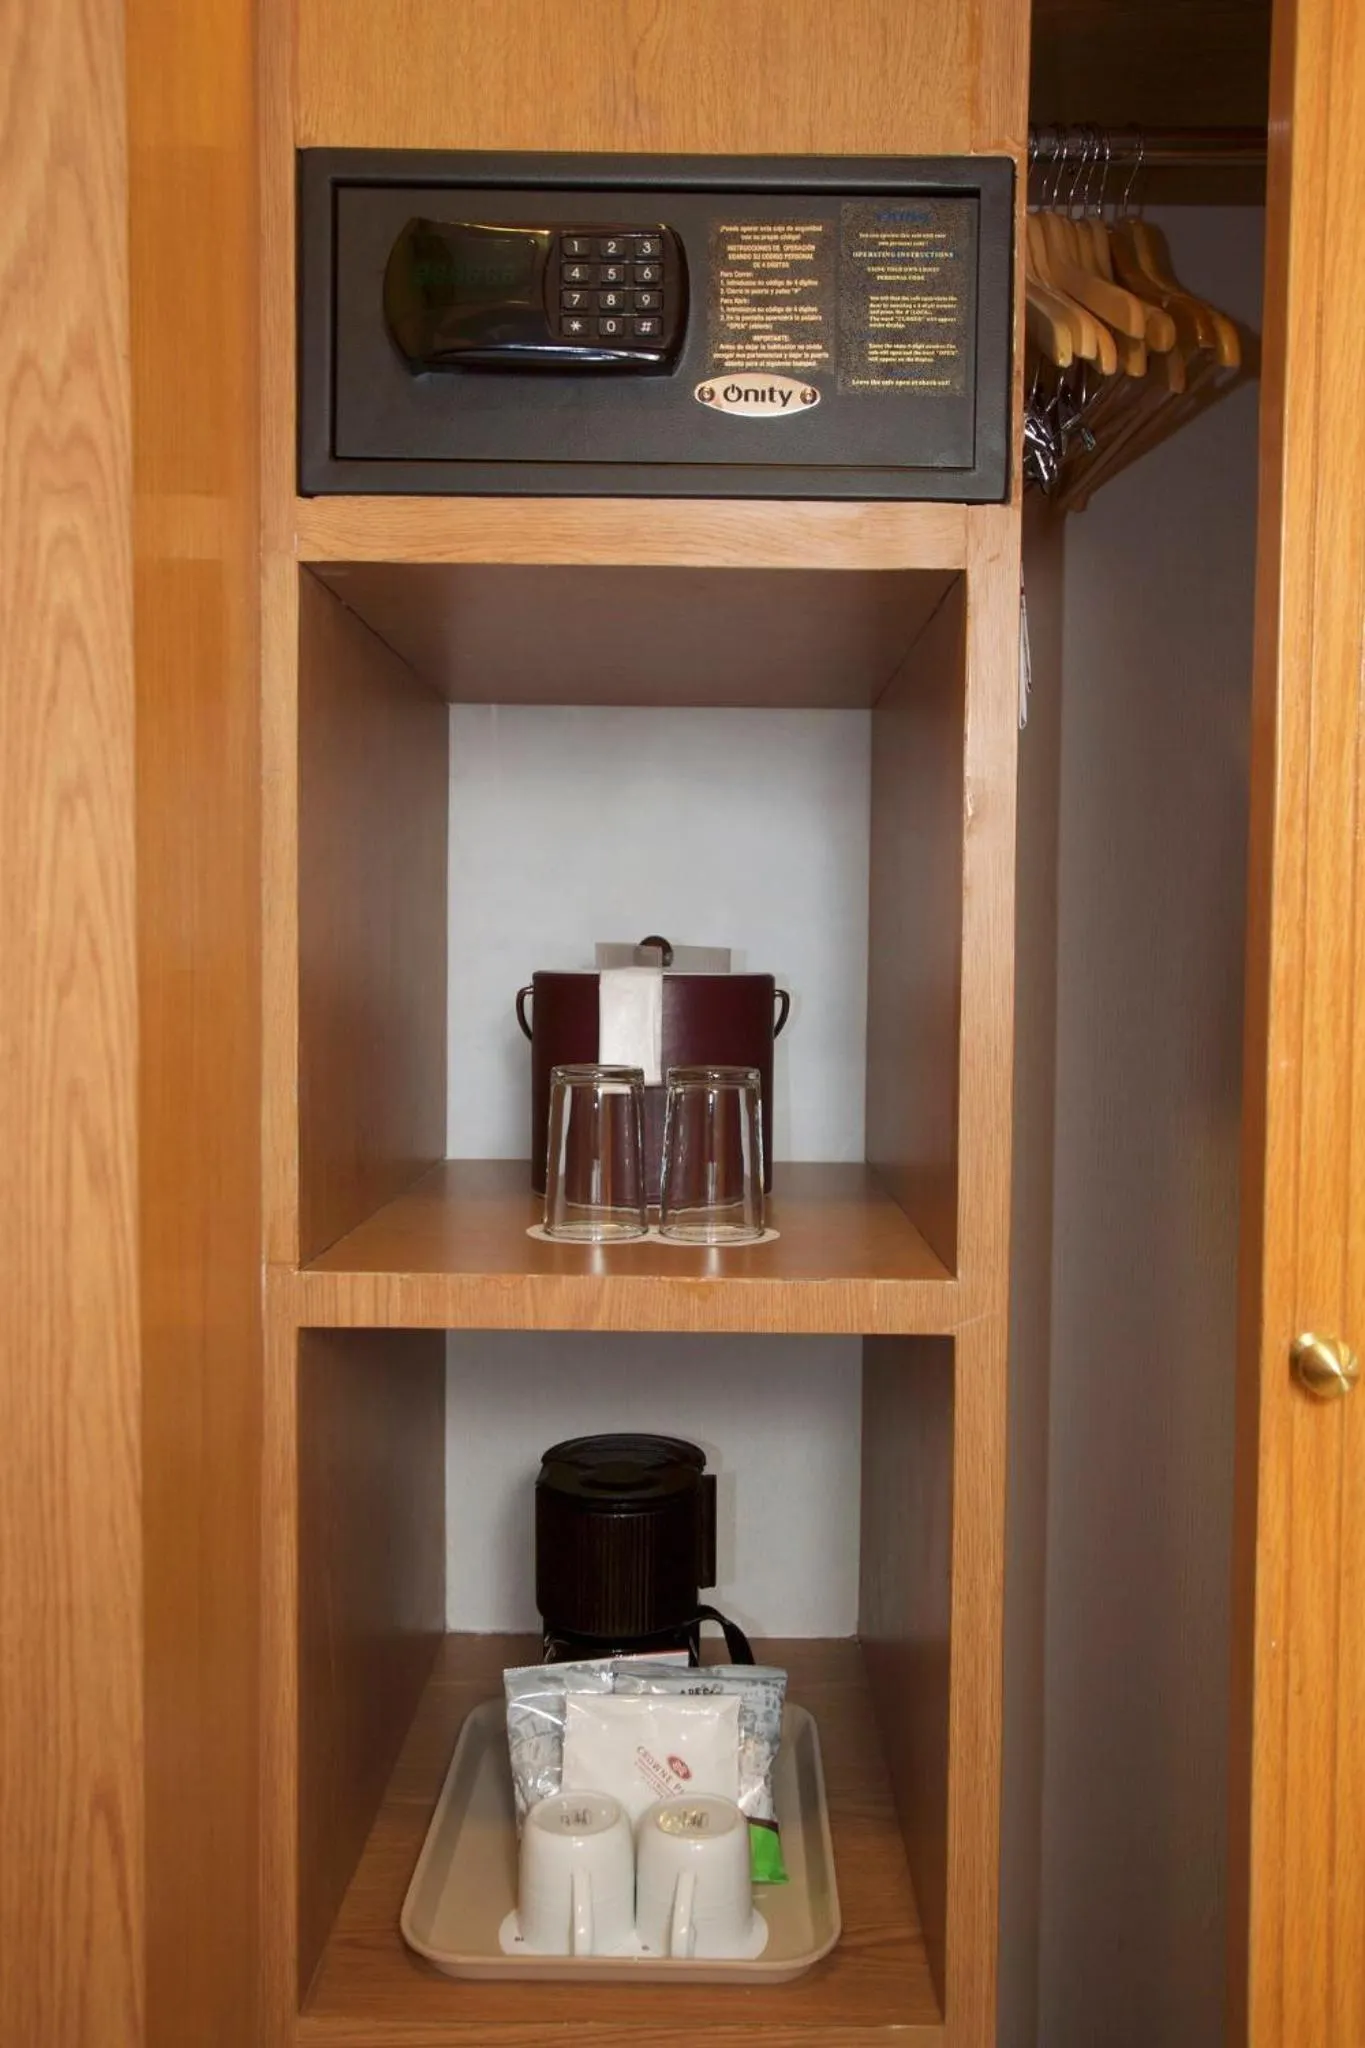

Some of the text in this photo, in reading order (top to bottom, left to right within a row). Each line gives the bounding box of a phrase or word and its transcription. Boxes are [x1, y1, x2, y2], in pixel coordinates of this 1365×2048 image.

[573, 240, 652, 254] 1 2 3
[571, 267, 652, 280] 4 5 6
[571, 294, 651, 306] 7 8 9
[606, 320, 652, 332] 0 #
[723, 384, 792, 407] Onity
[636, 1744, 673, 1784] CROWNE
